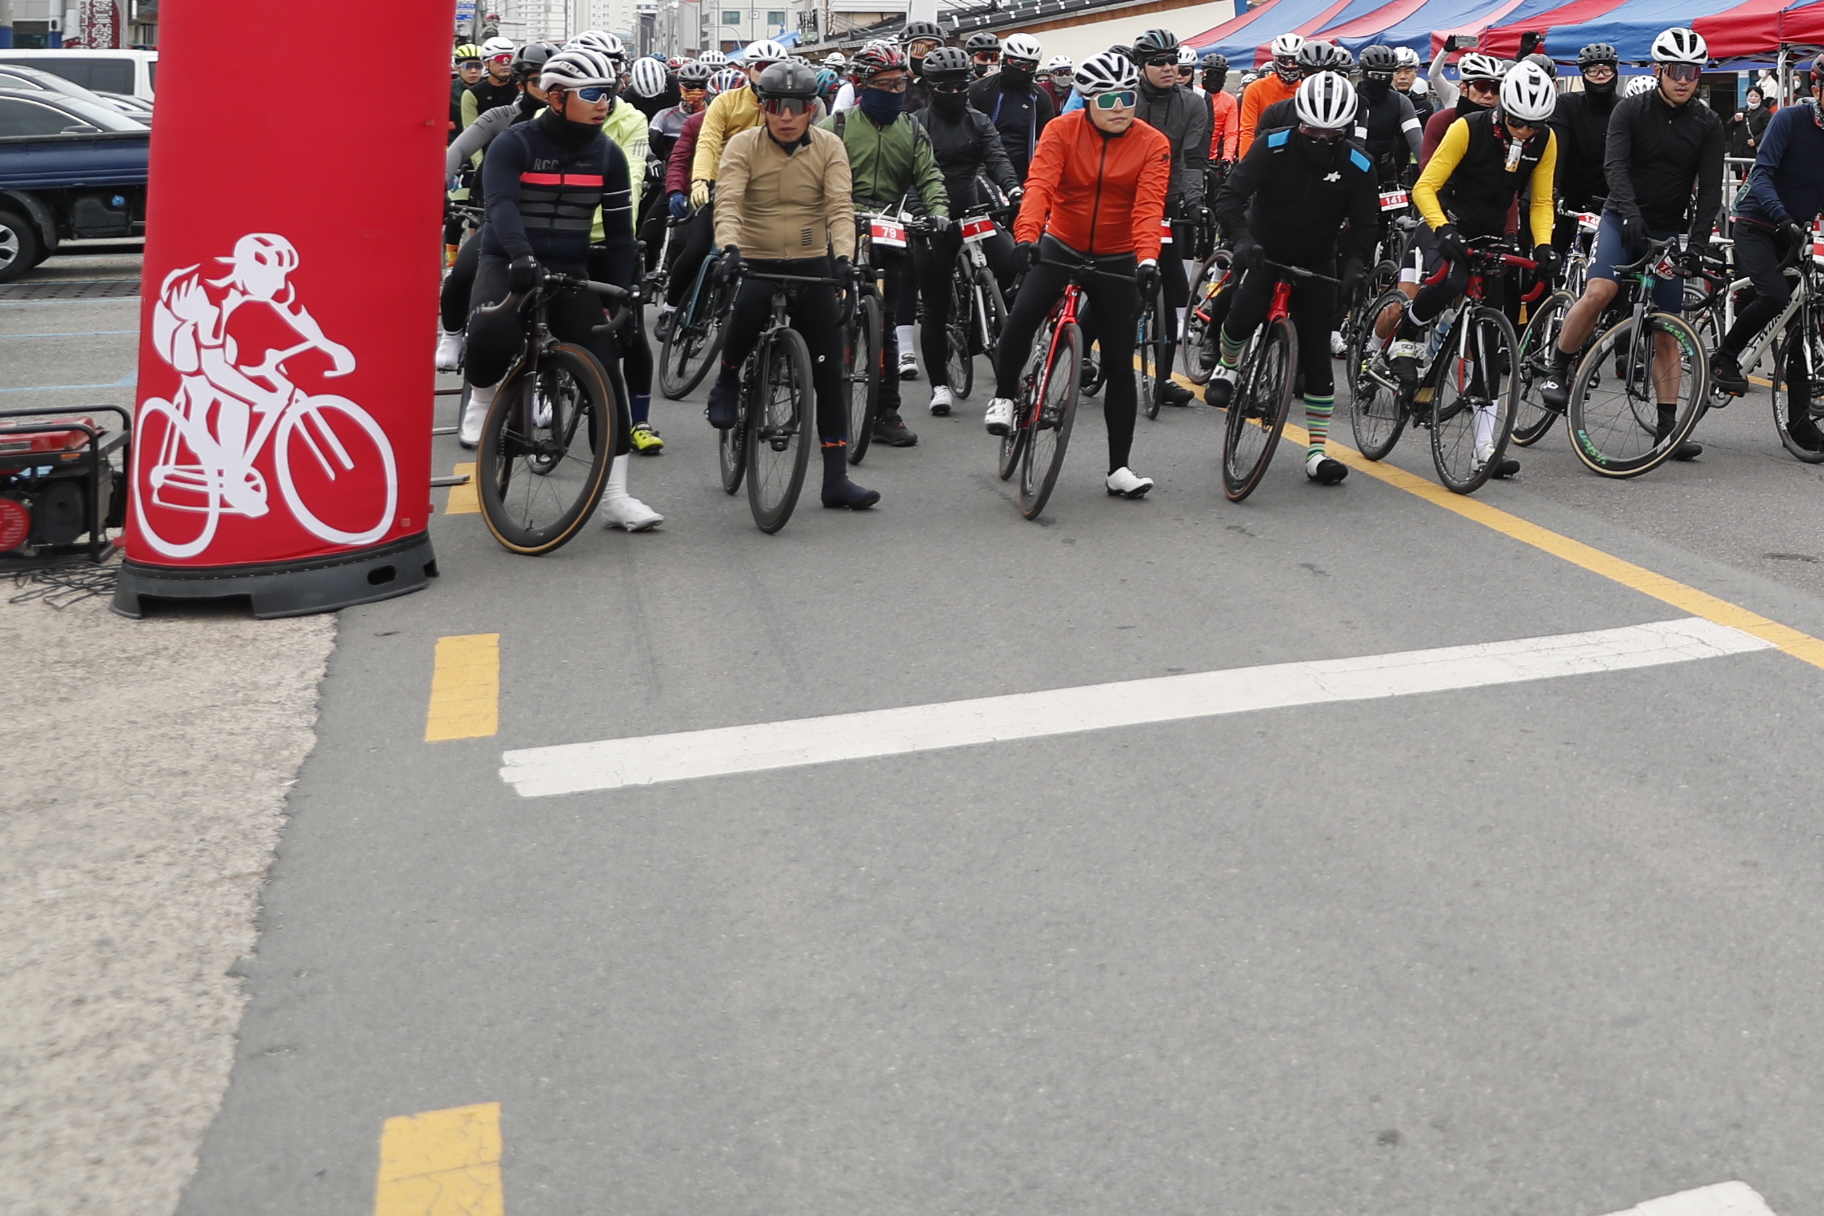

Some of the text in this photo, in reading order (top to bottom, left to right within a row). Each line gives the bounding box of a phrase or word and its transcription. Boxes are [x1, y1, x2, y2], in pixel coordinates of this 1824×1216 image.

[533, 157, 559, 171] RCC
[1385, 195, 1402, 205] 141
[881, 226, 898, 239] 79
